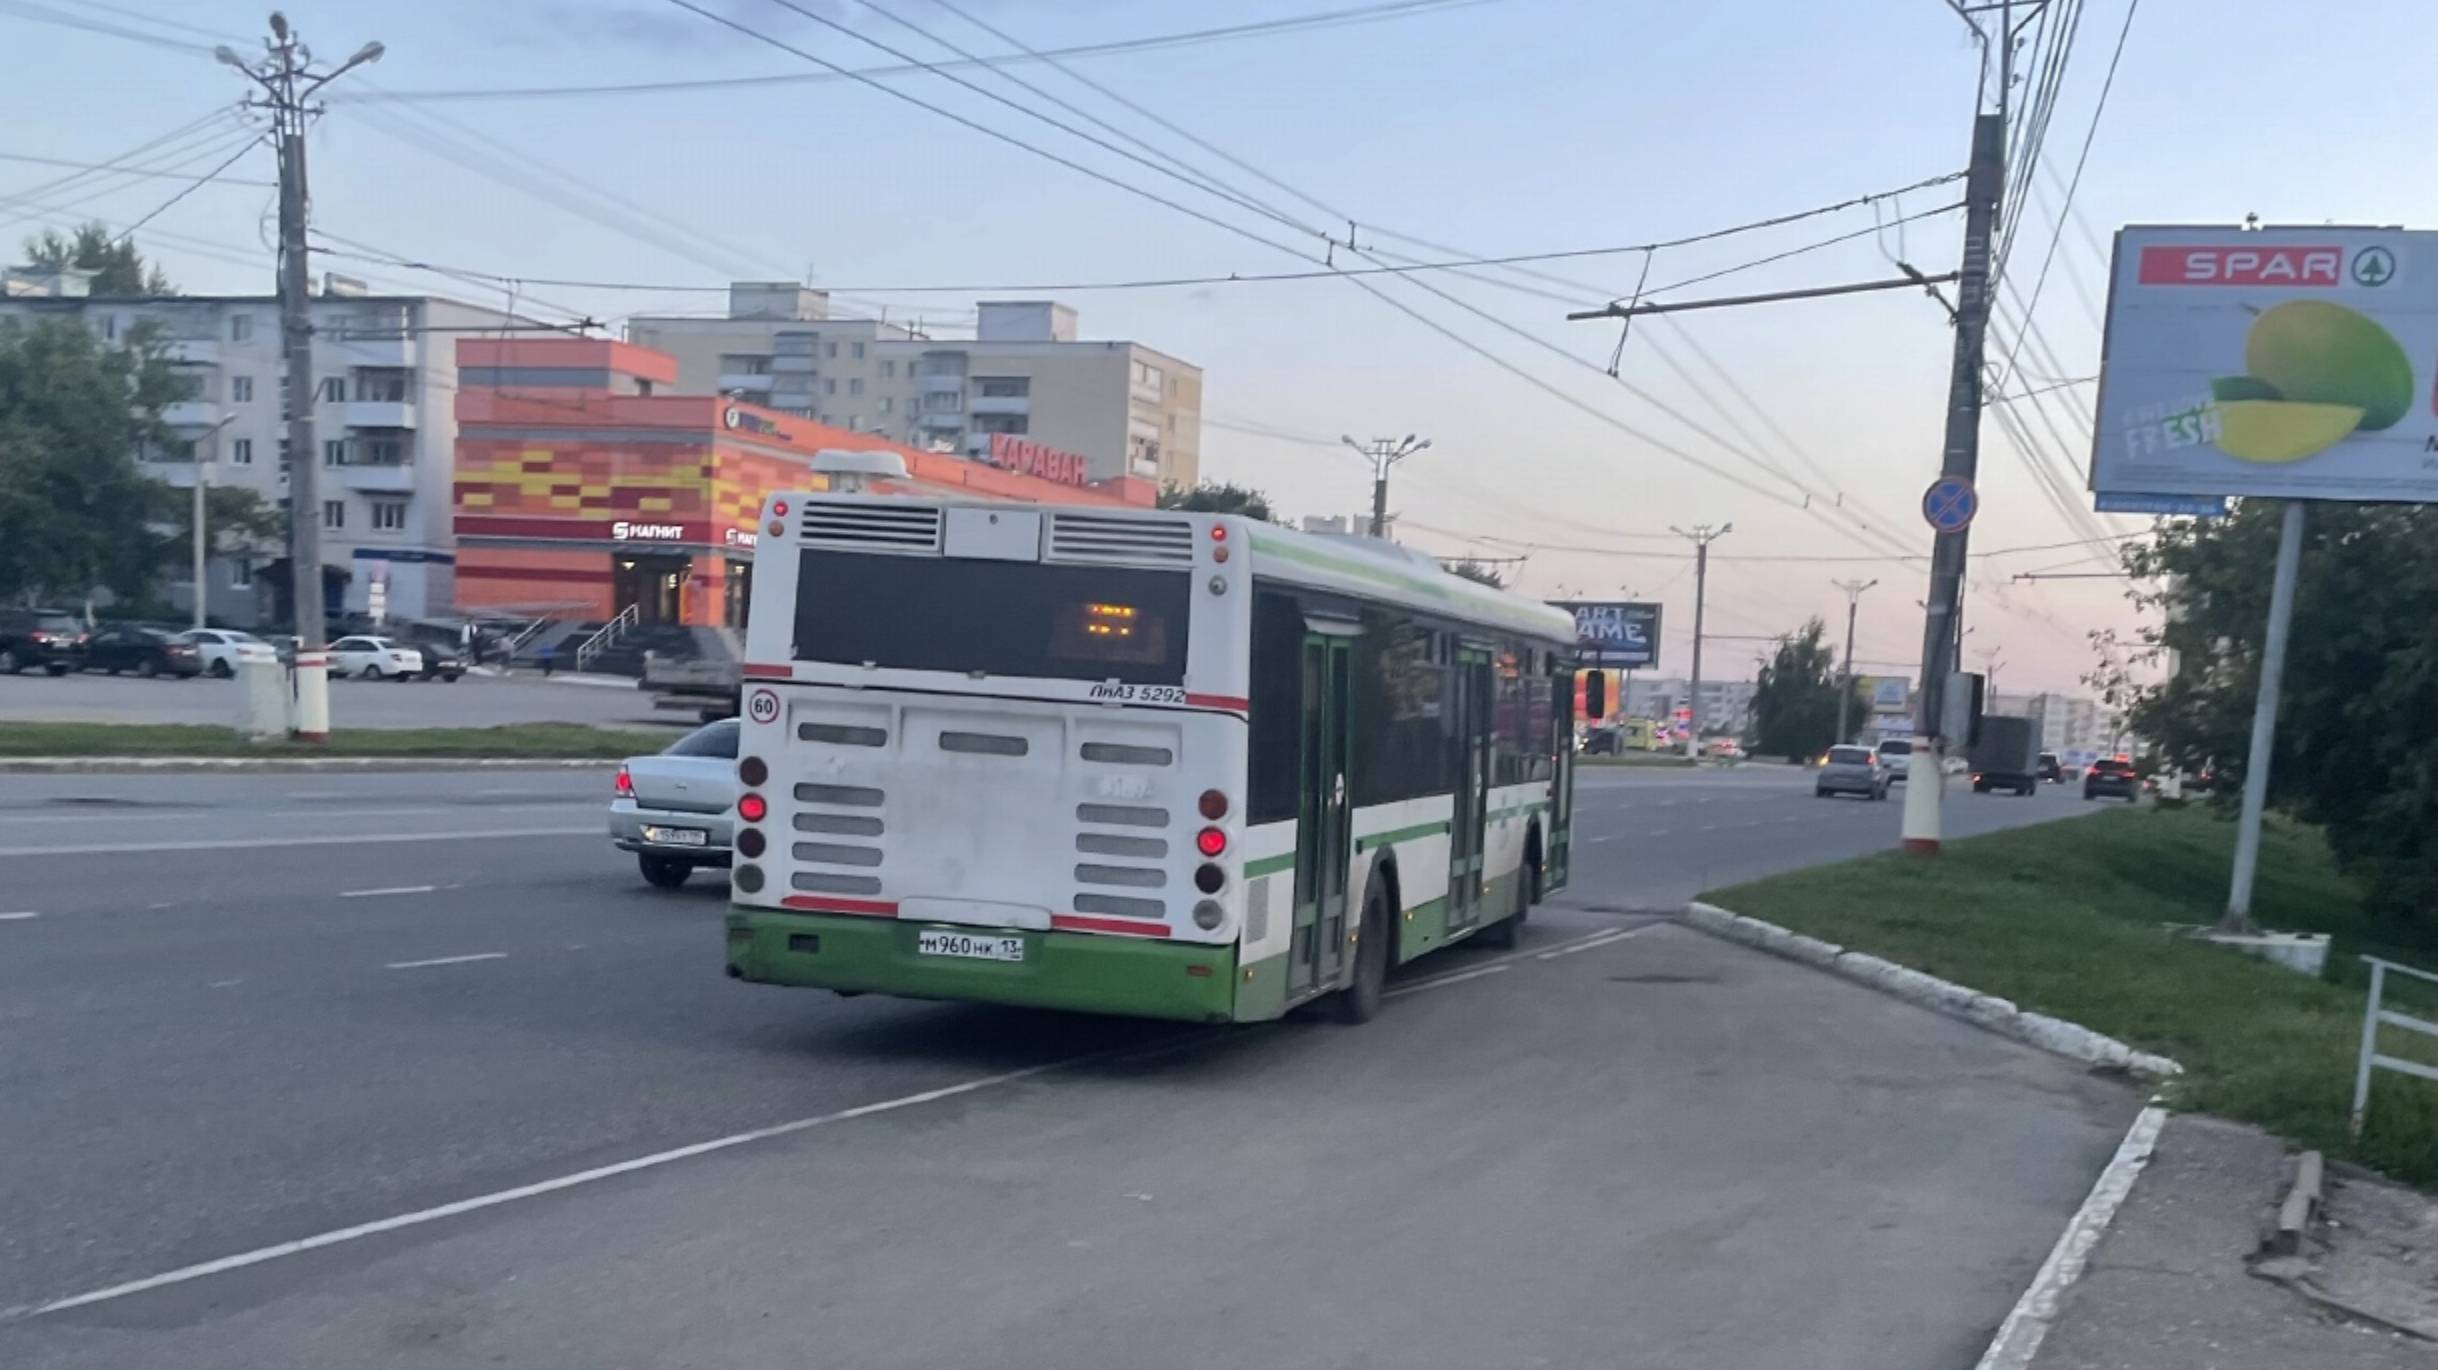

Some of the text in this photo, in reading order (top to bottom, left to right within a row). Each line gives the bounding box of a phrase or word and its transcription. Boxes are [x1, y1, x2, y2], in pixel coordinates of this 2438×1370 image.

[2184, 251, 2338, 280] SPAR
[991, 432, 1088, 487] КАРАВАН
[629, 524, 684, 540] МАГНИТ
[1576, 621, 1647, 644] AME
[1139, 687, 1185, 703] 5292
[754, 698, 773, 714] 60
[1001, 939, 1017, 953] 13
